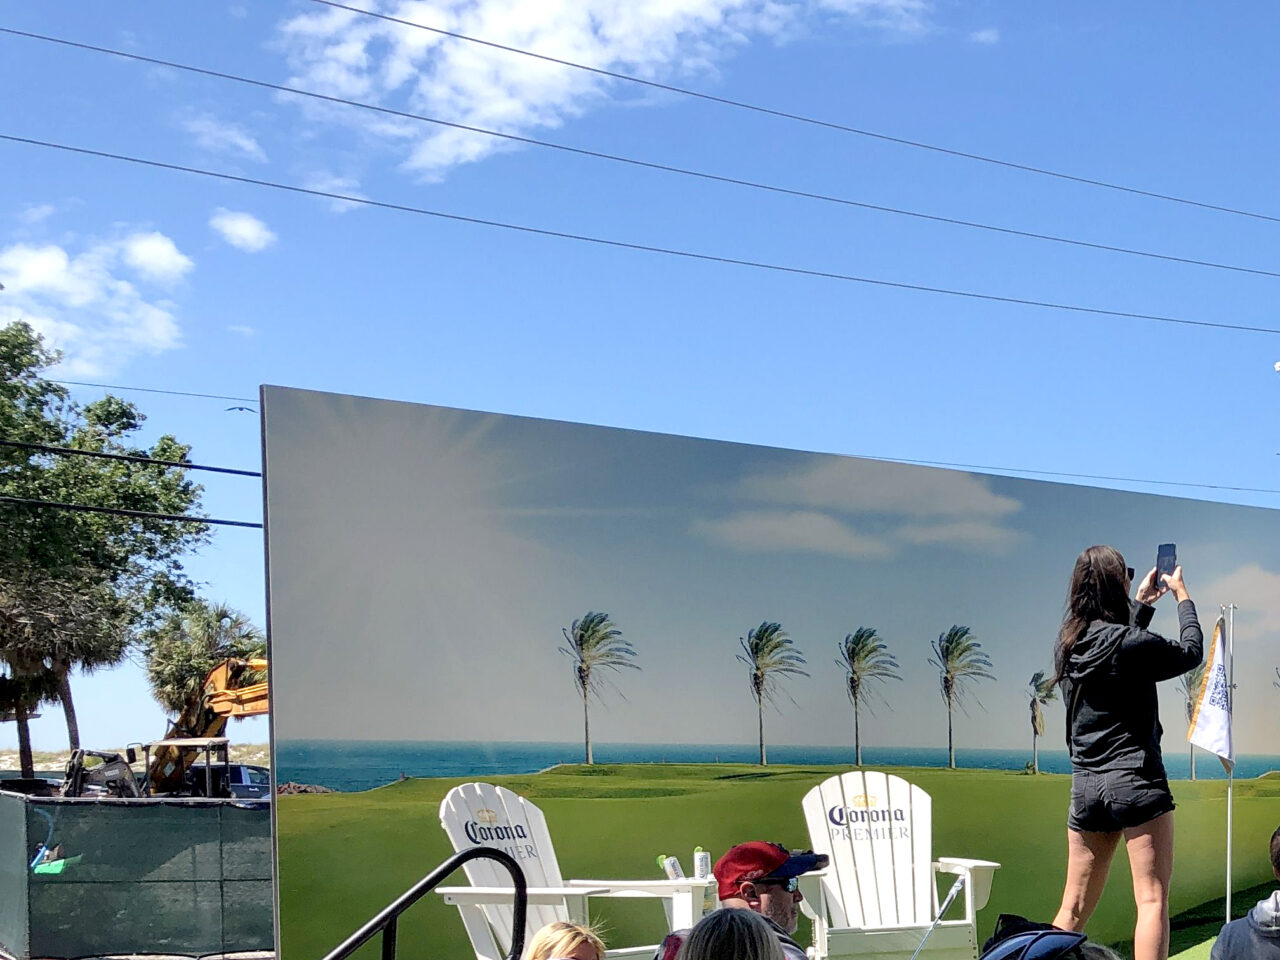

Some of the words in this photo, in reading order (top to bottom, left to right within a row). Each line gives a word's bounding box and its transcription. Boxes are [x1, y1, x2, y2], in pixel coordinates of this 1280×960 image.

[828, 805, 905, 828] Corona
[464, 820, 528, 845] Corona
[831, 827, 909, 841] PREMIER
